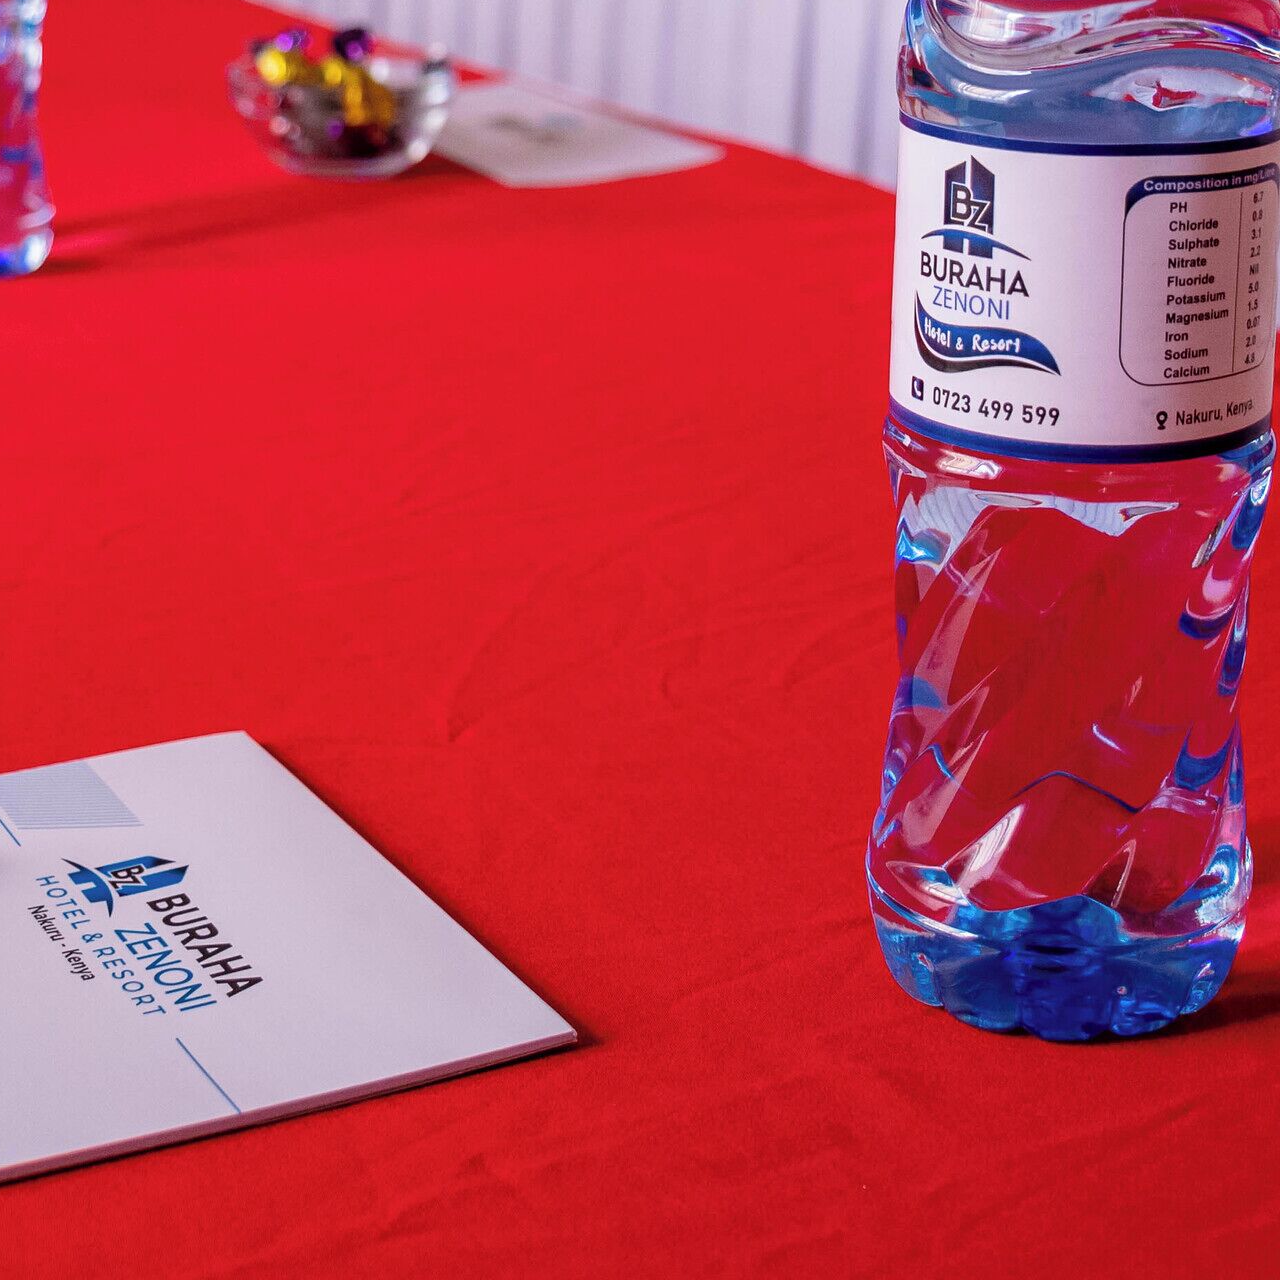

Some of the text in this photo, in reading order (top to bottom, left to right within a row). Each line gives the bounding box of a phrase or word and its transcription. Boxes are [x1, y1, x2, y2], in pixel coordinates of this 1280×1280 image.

[1143, 177, 1229, 192] Composition
[1231, 175, 1241, 185] in
[1170, 201, 1187, 213] PH
[1169, 218, 1219, 232] Chloride
[1168, 238, 1220, 252] Sulphate
[1167, 258, 1207, 269] Nitrate
[920, 250, 1030, 298] BURAHA
[1167, 274, 1215, 287] Fluoride
[932, 285, 1010, 320] ZENONI
[1166, 291, 1226, 306] Potassium
[1165, 308, 1229, 325] Magnesium
[924, 317, 1021, 353] Hotel & Resort
[1165, 331, 1189, 342] Iron
[1164, 347, 1209, 360] Sodium
[1163, 366, 1210, 379] Calcium
[932, 386, 1060, 426] 0723 499 599
[1176, 408, 1223, 426] Nakuru,
[28, 904, 65, 943] Nakuru
[61, 948, 96, 981] Kenya
[35, 874, 167, 1016] HOTEL & RESORT
[146, 892, 264, 998] BURAHA
[114, 922, 218, 1012] ZENONI
